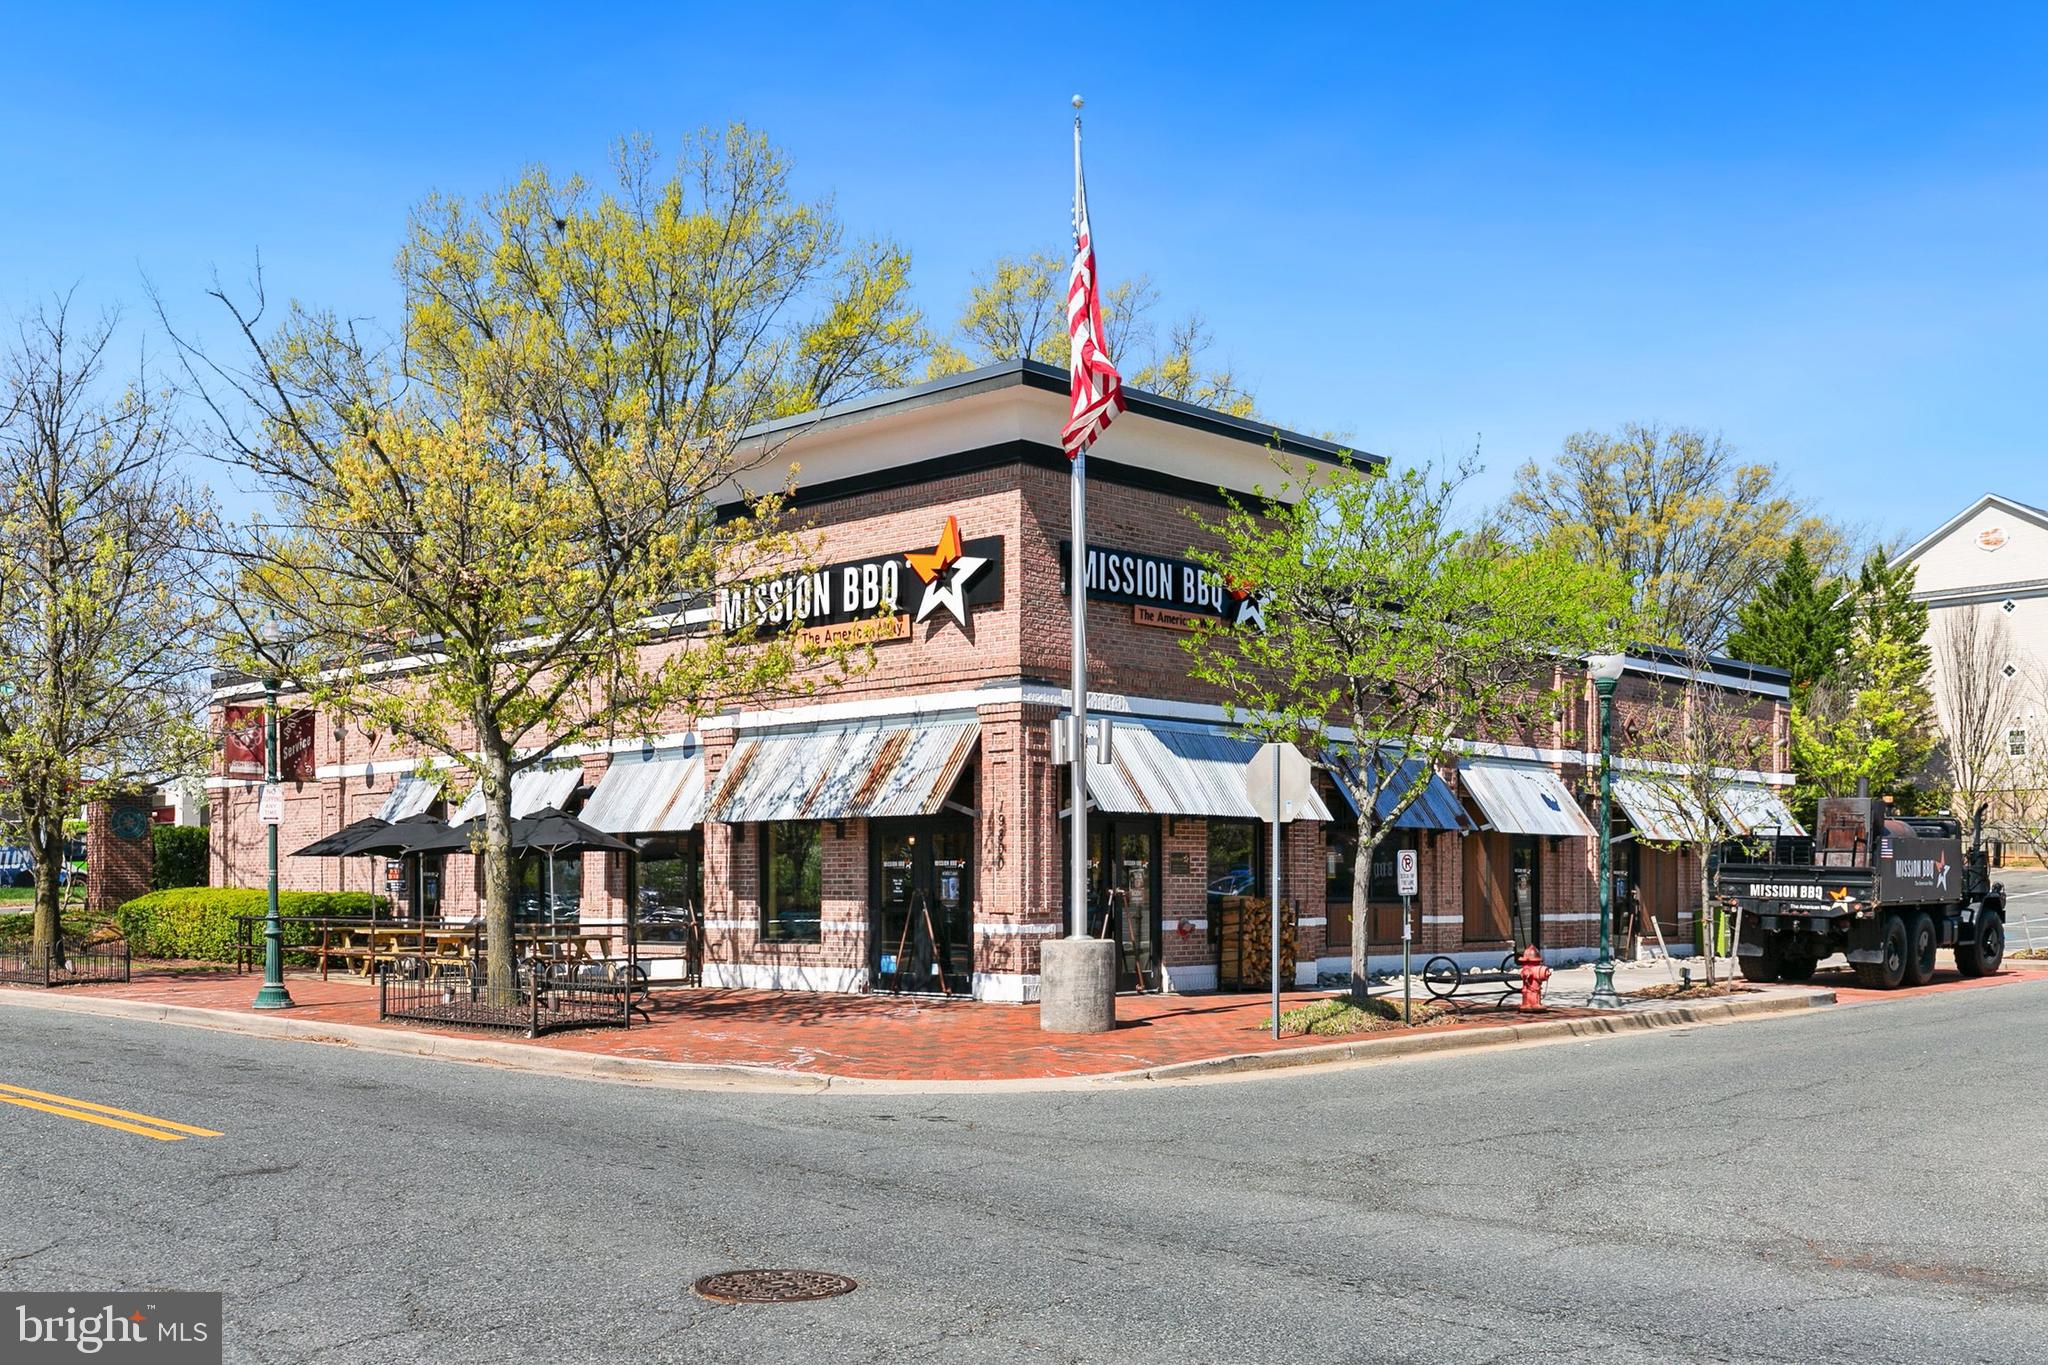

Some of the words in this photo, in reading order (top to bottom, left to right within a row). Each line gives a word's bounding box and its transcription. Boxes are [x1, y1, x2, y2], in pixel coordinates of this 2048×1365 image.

[1085, 550, 1173, 600] MISSION
[1183, 567, 1223, 613] BBQ
[720, 570, 830, 631] MISSION
[843, 560, 899, 612] BBQ
[1139, 607, 1154, 621] The
[1157, 611, 1193, 627] Americ
[802, 631, 820, 645] The
[283, 735, 311, 760] Service
[1895, 859, 1921, 878] MISSION
[1922, 859, 1935, 879] BBQ
[1749, 884, 1798, 898] MISSION
[1800, 885, 1823, 900] BBQ
